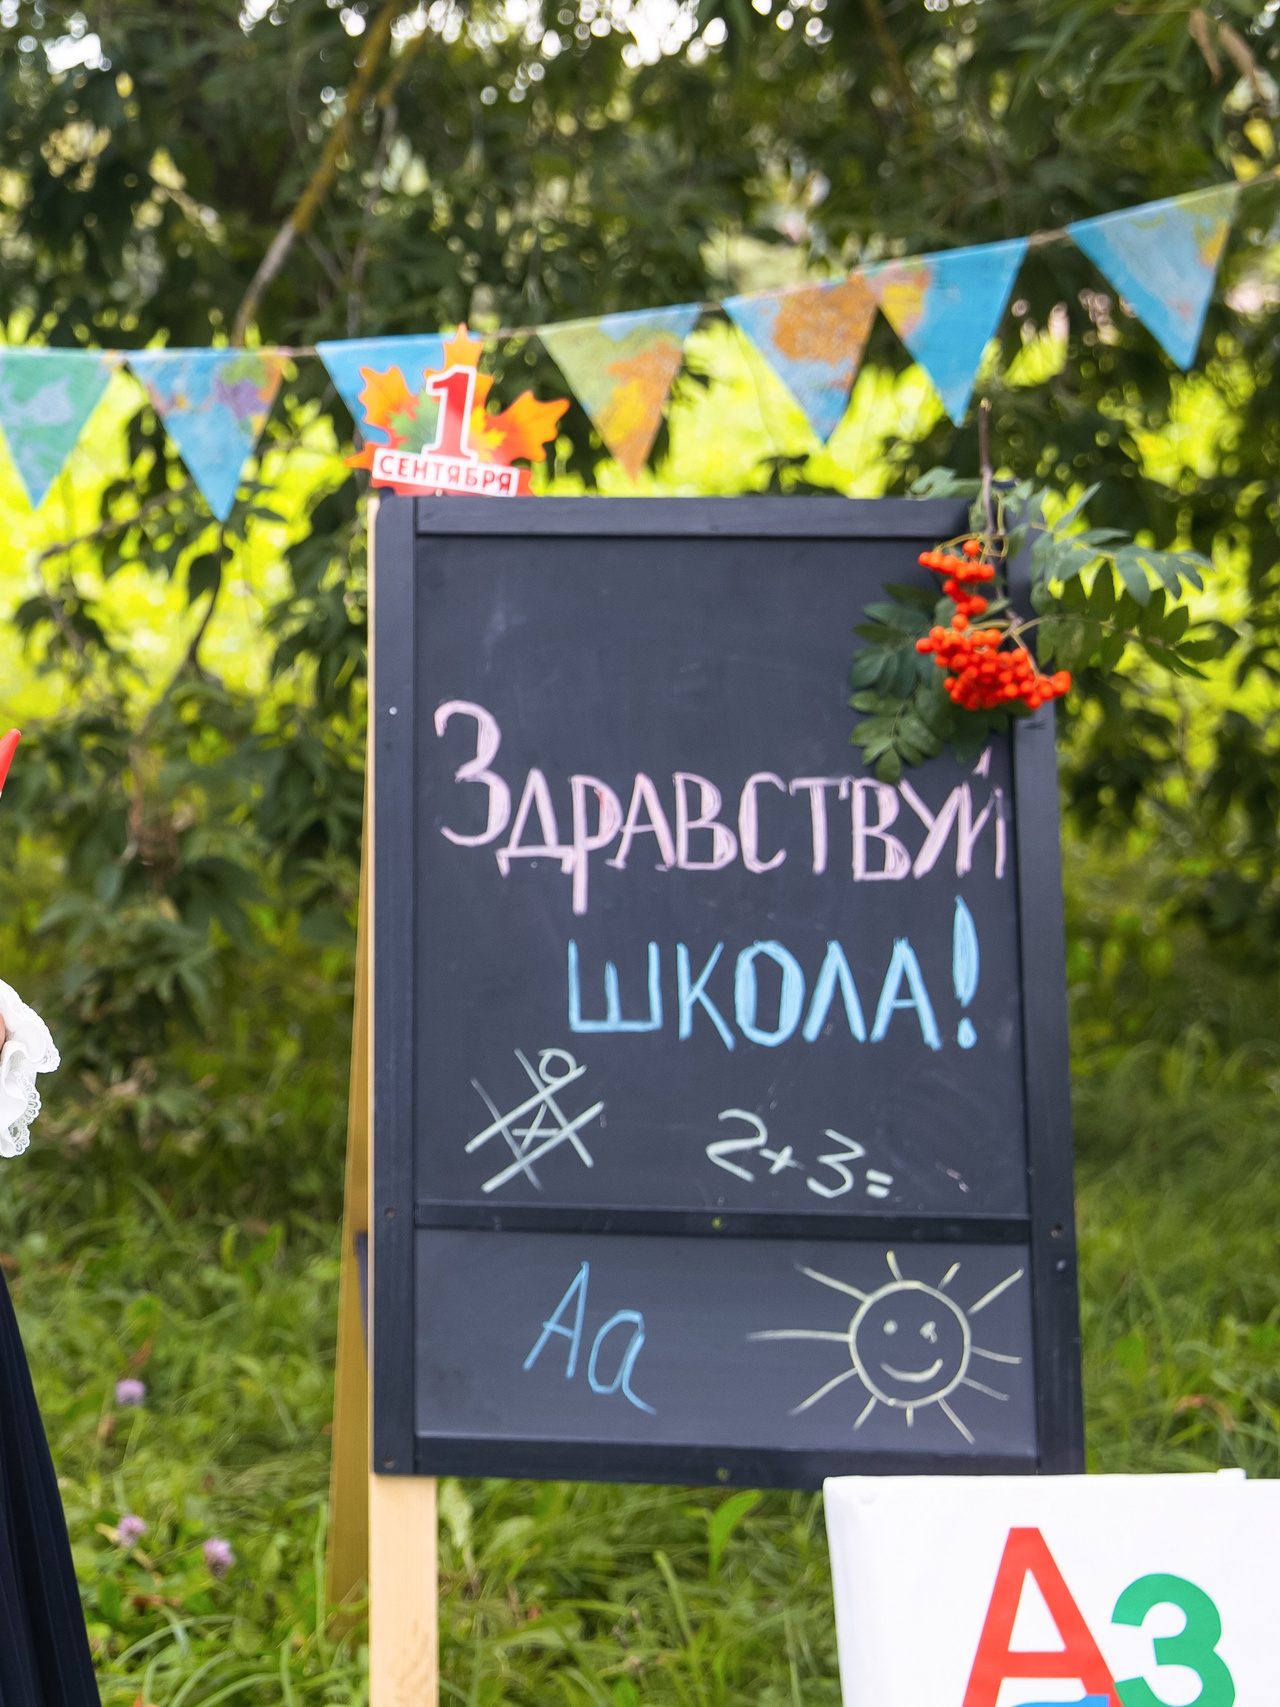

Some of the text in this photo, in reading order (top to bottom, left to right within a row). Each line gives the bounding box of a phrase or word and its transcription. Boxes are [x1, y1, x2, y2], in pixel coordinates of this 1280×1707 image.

[427, 368, 475, 461] 1
[379, 455, 513, 493] СЕНТЯБРЯ
[705, 1108, 893, 1199] 2+3=
[523, 1260, 657, 1416] Аа
